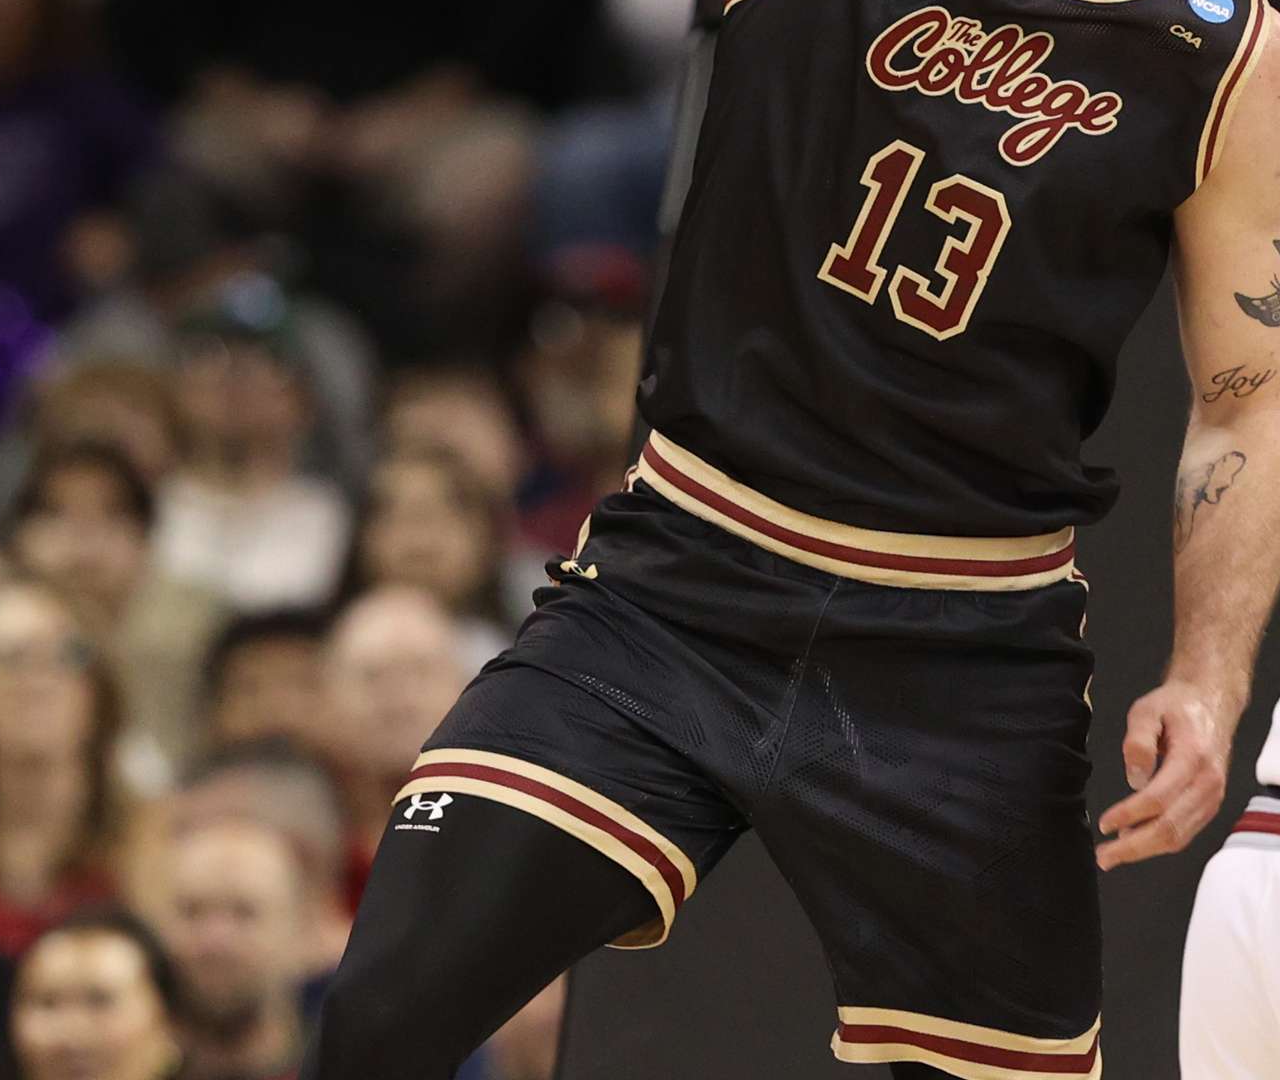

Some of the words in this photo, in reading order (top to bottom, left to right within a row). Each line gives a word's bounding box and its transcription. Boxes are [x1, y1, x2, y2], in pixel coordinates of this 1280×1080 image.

[947, 19, 983, 48] The
[1169, 25, 1202, 48] CAA
[866, 6, 1122, 167] College
[817, 139, 1012, 341] 13
[1202, 364, 1277, 404] Joy
